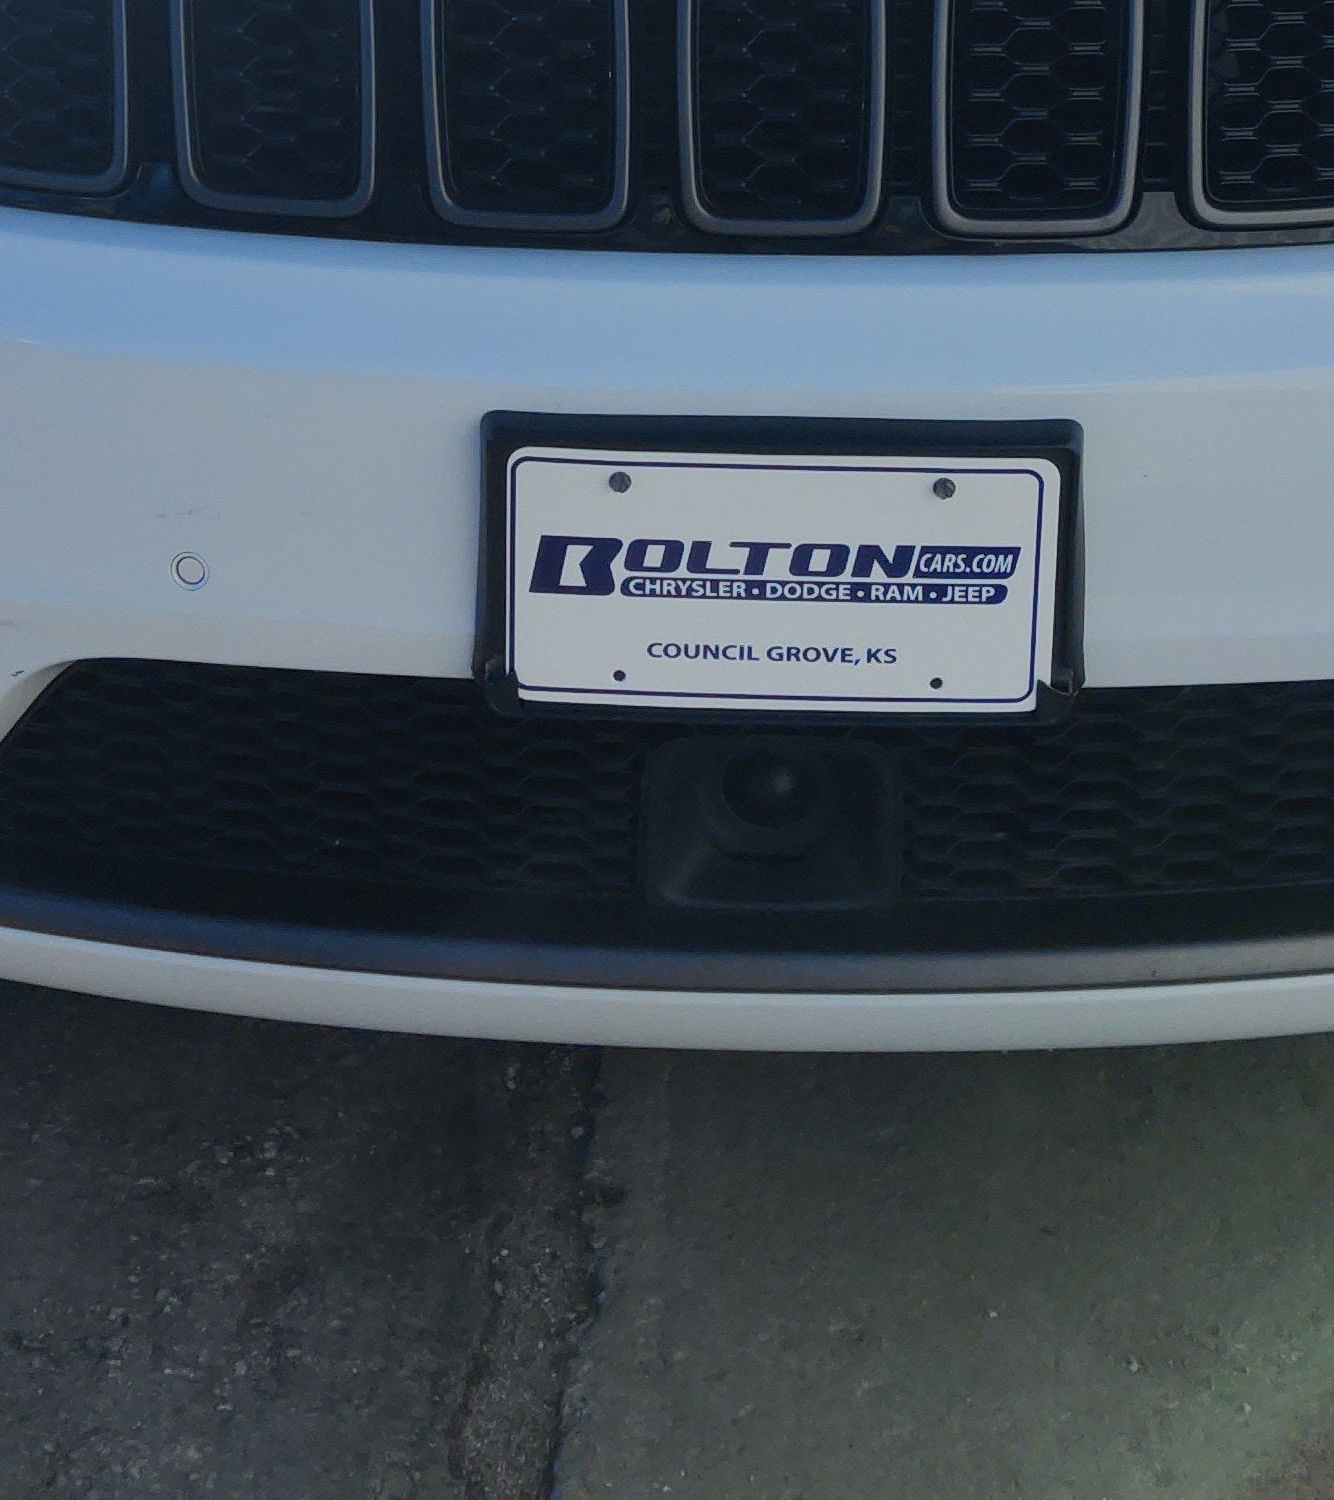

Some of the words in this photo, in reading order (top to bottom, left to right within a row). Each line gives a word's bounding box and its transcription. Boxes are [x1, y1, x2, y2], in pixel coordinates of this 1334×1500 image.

[529, 535, 917, 596] BOLTON
[919, 552, 1014, 574] CARS.COM
[628, 578, 746, 597] CHRYSLER
[766, 582, 851, 600] DODGE
[870, 584, 924, 602] RAM
[941, 585, 995, 603] JEEP
[646, 642, 760, 661] COUNCIL
[766, 645, 862, 666] GROVE,
[866, 647, 898, 665] KS
